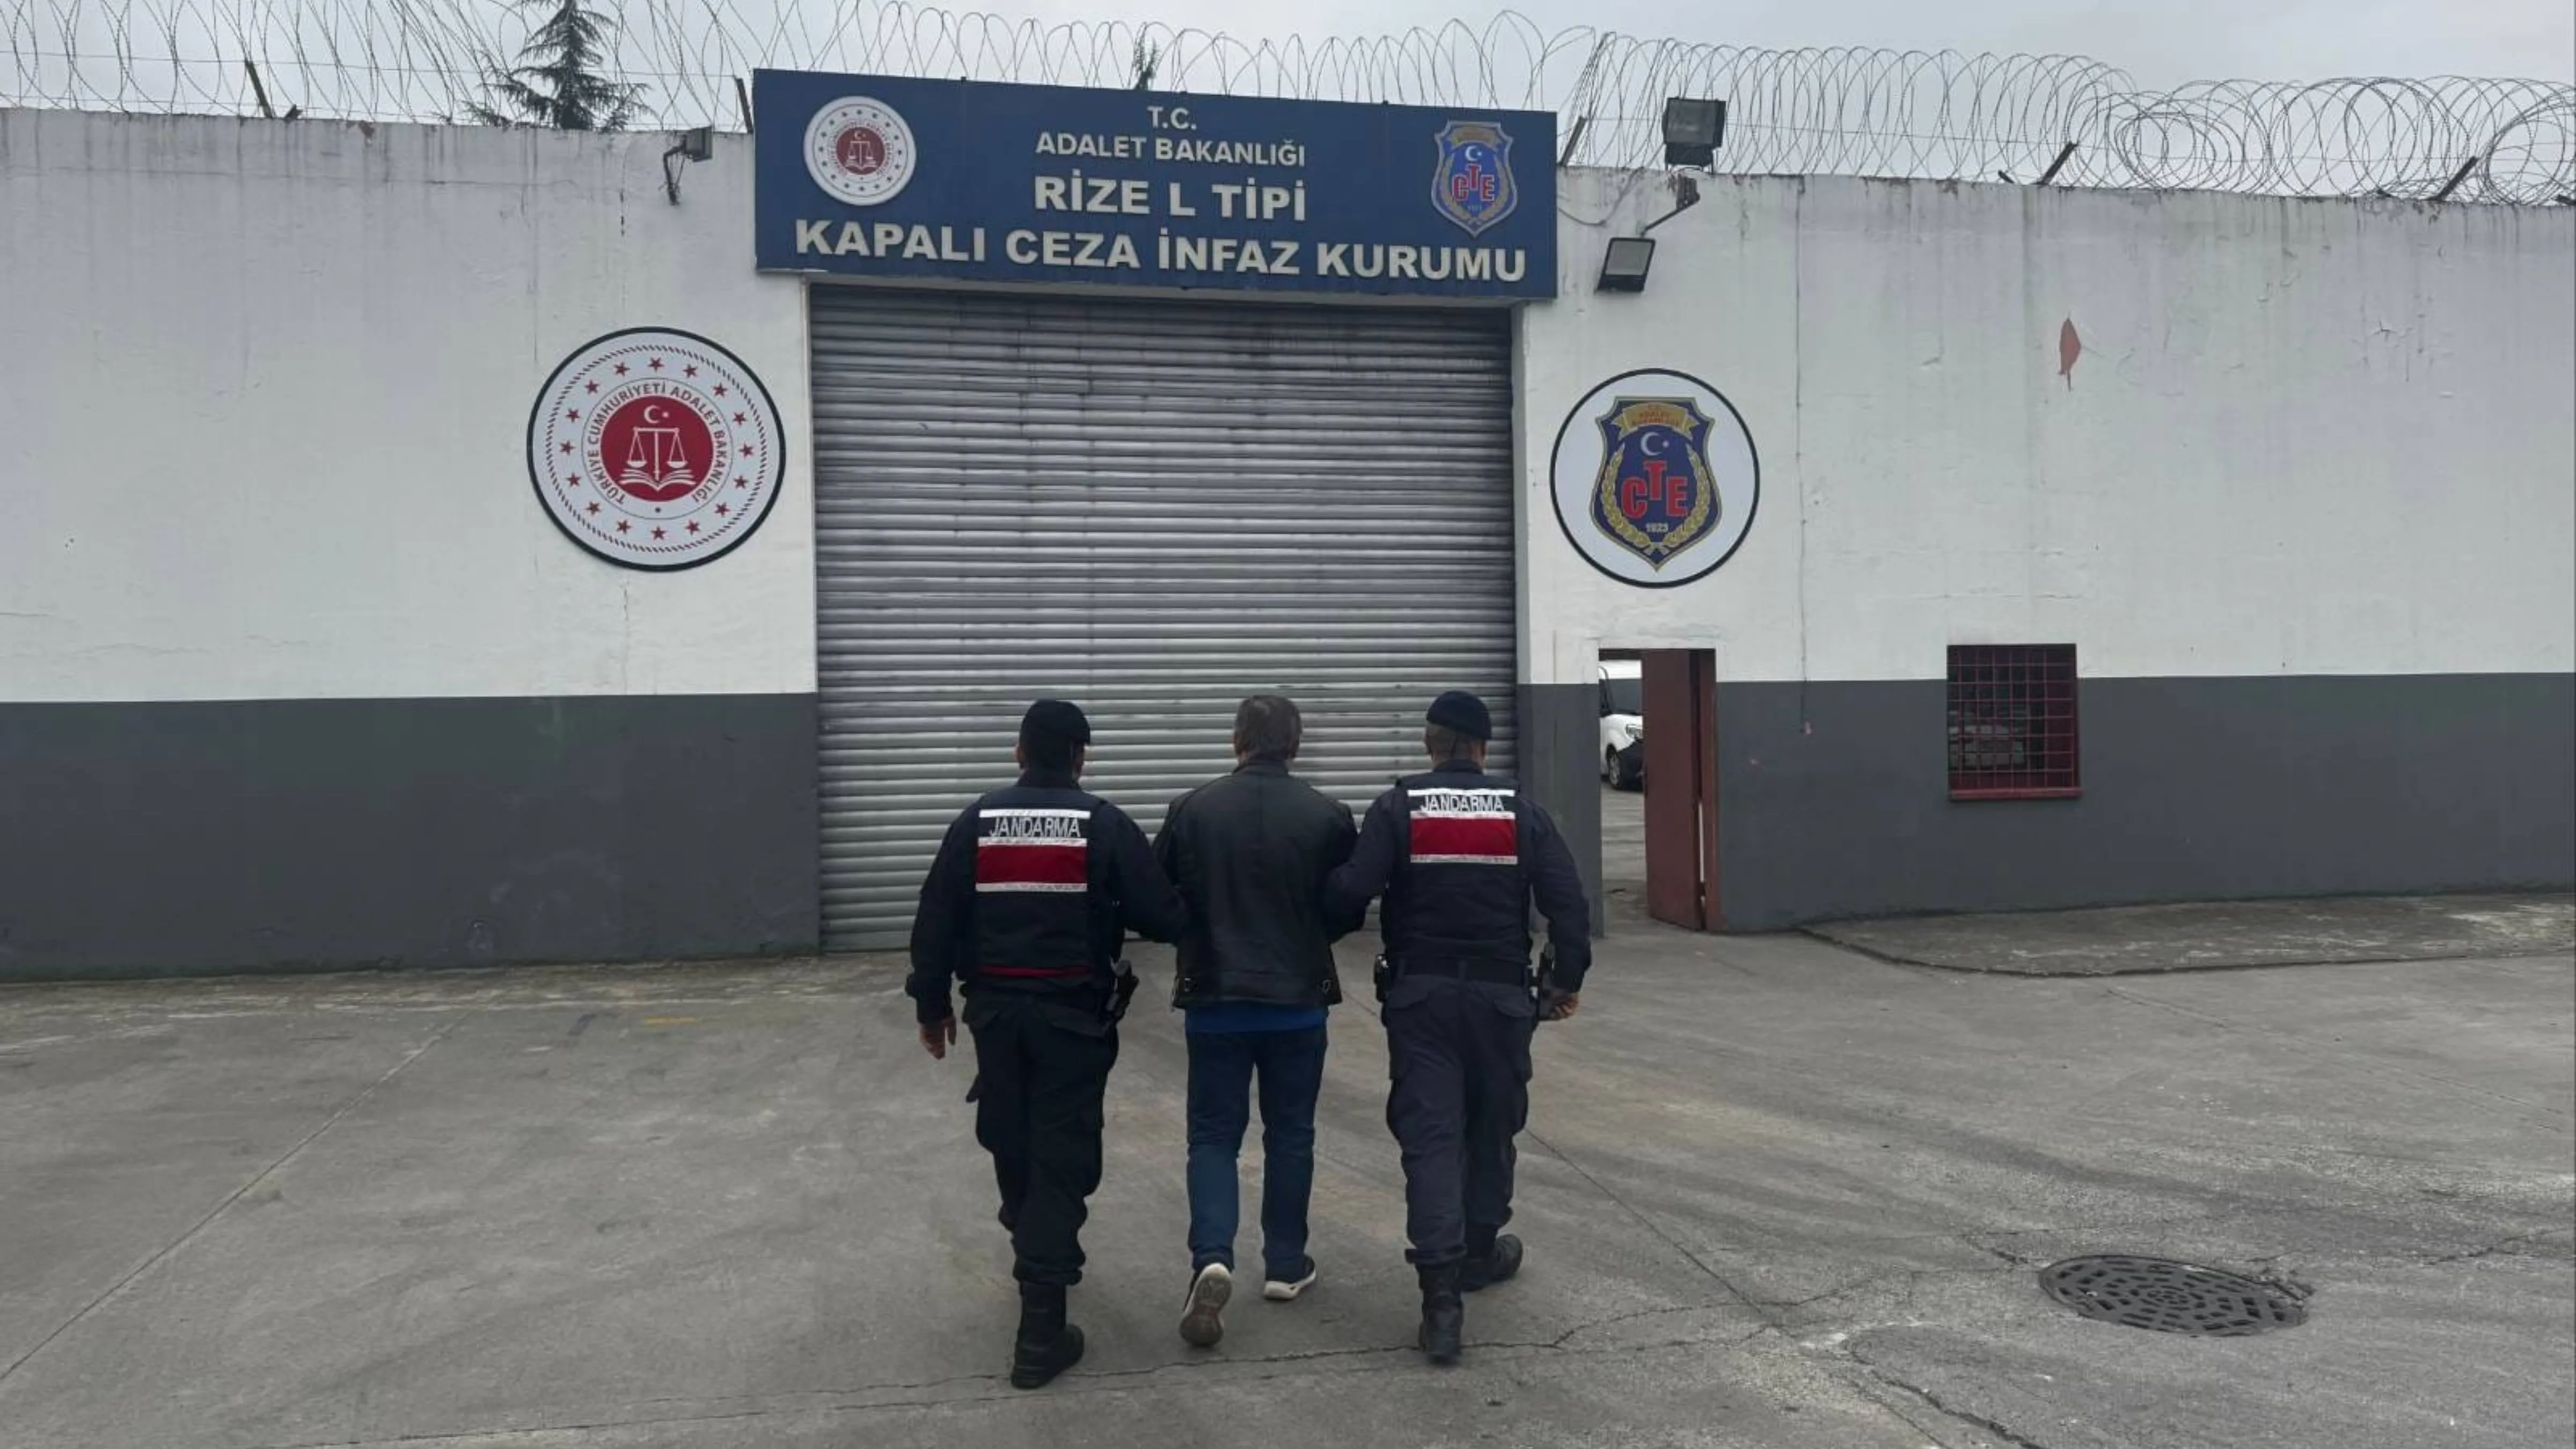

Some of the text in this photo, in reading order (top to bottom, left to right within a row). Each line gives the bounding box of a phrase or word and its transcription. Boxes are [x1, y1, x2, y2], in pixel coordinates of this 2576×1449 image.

[1147, 106, 1197, 130] T.C.
[1035, 131, 1305, 167] ADALET BAKANLIĞI
[1035, 169, 1305, 221] RİZE L TİPİ
[795, 218, 1525, 282] KAPALI CEZA İNFAZ KURUMU
[588, 380, 727, 504] TÜRKİYE CUMHURİYETİ ADALET BAKANLIĞI
[1621, 460, 1688, 519] CTE
[1420, 794, 1504, 812] JANDARMA
[989, 816, 1081, 838] JANDARMA
